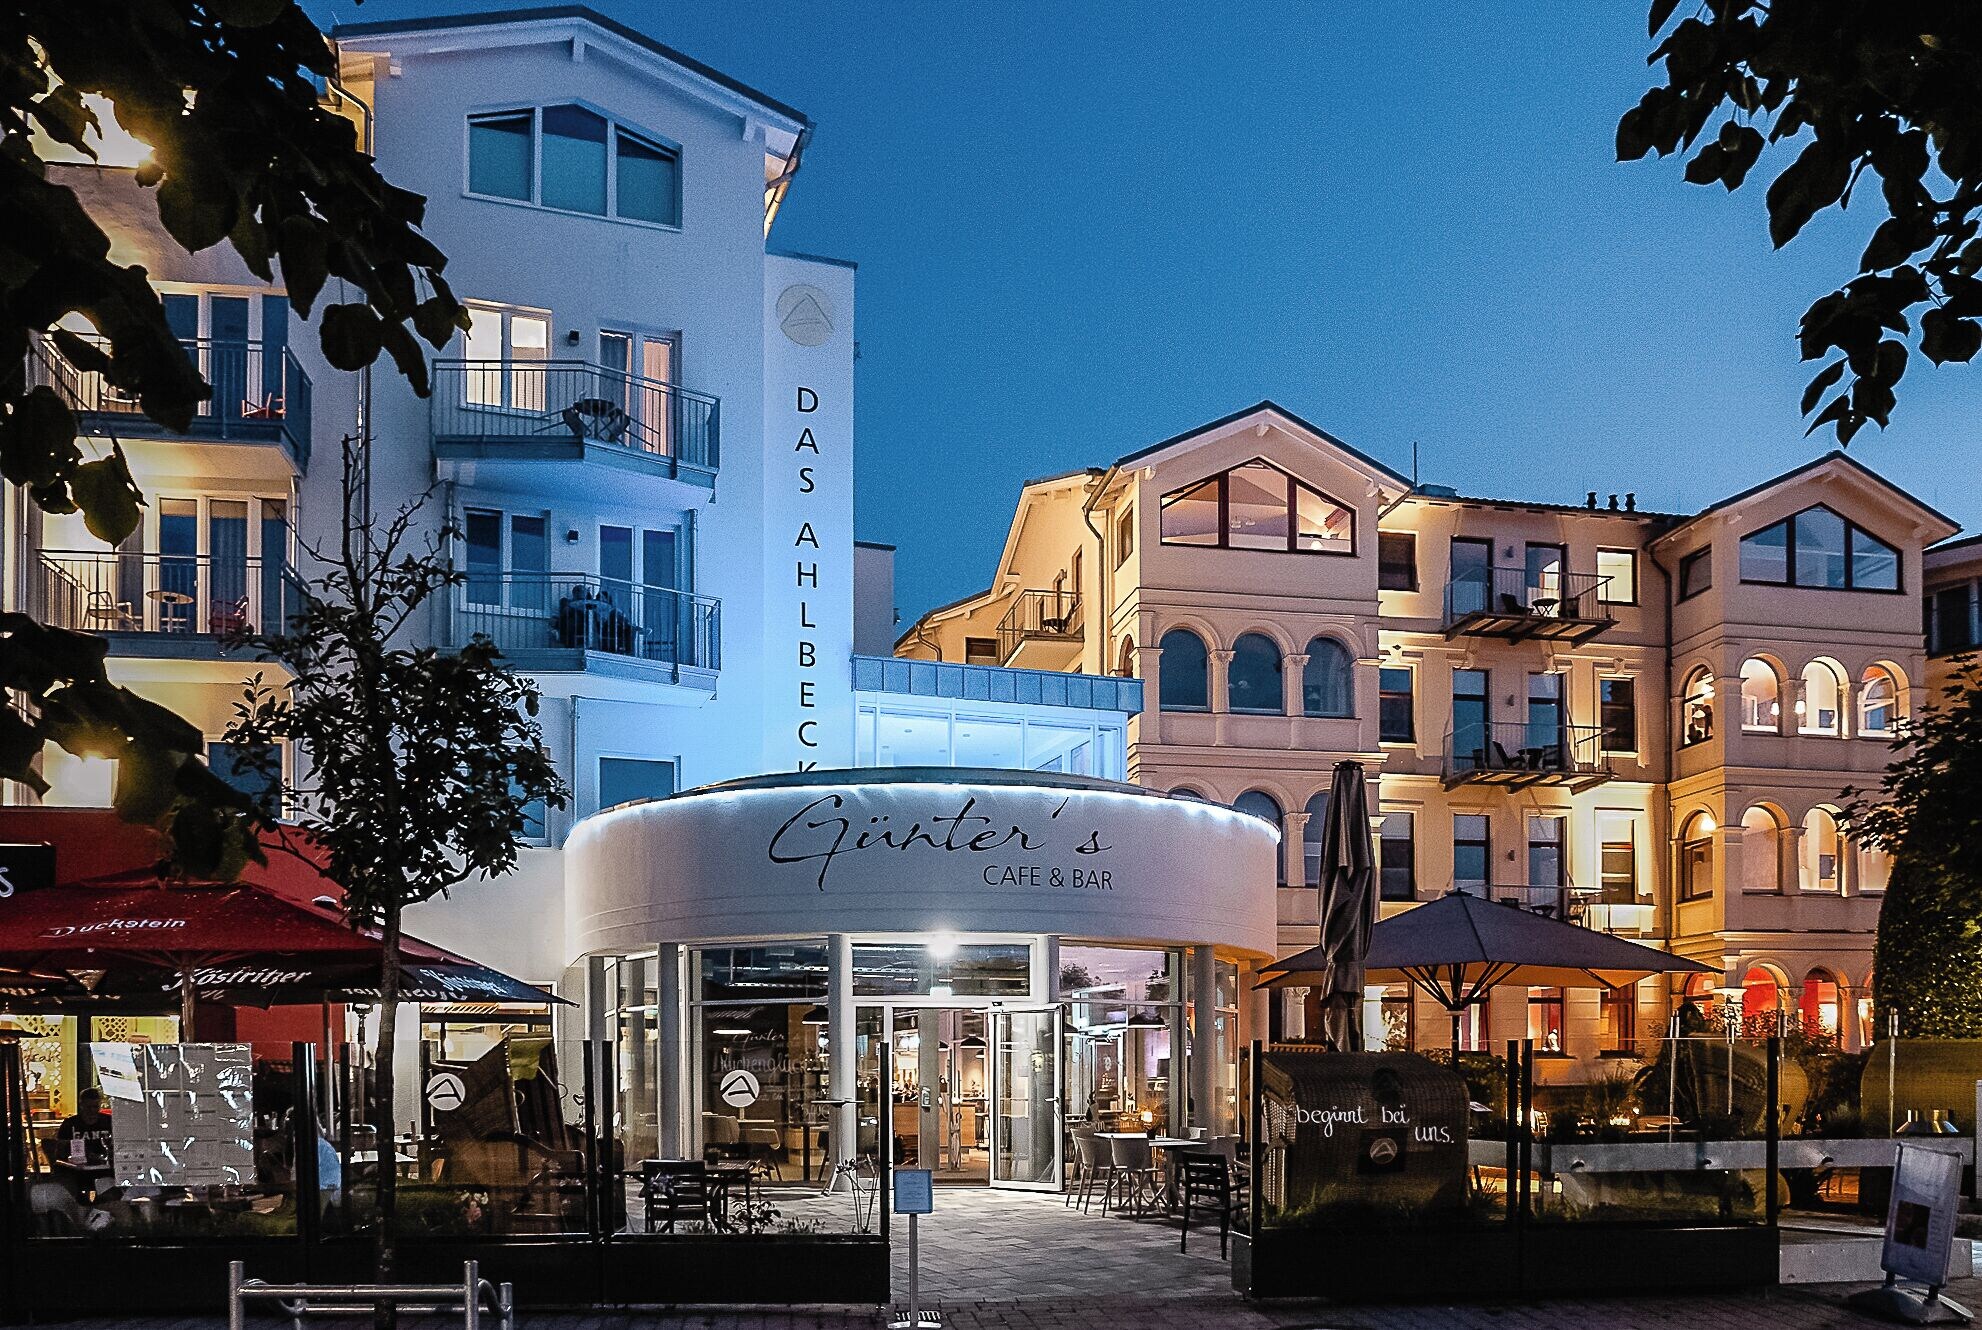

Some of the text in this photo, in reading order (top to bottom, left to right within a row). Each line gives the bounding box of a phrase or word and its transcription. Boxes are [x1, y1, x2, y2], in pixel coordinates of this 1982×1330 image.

[795, 386, 819, 494] DAS
[983, 865, 1113, 890] CAFE & BAR
[39, 918, 187, 938] Duckstein
[1296, 1104, 1410, 1137] beginnt bei
[1415, 1125, 1455, 1143] uns.
